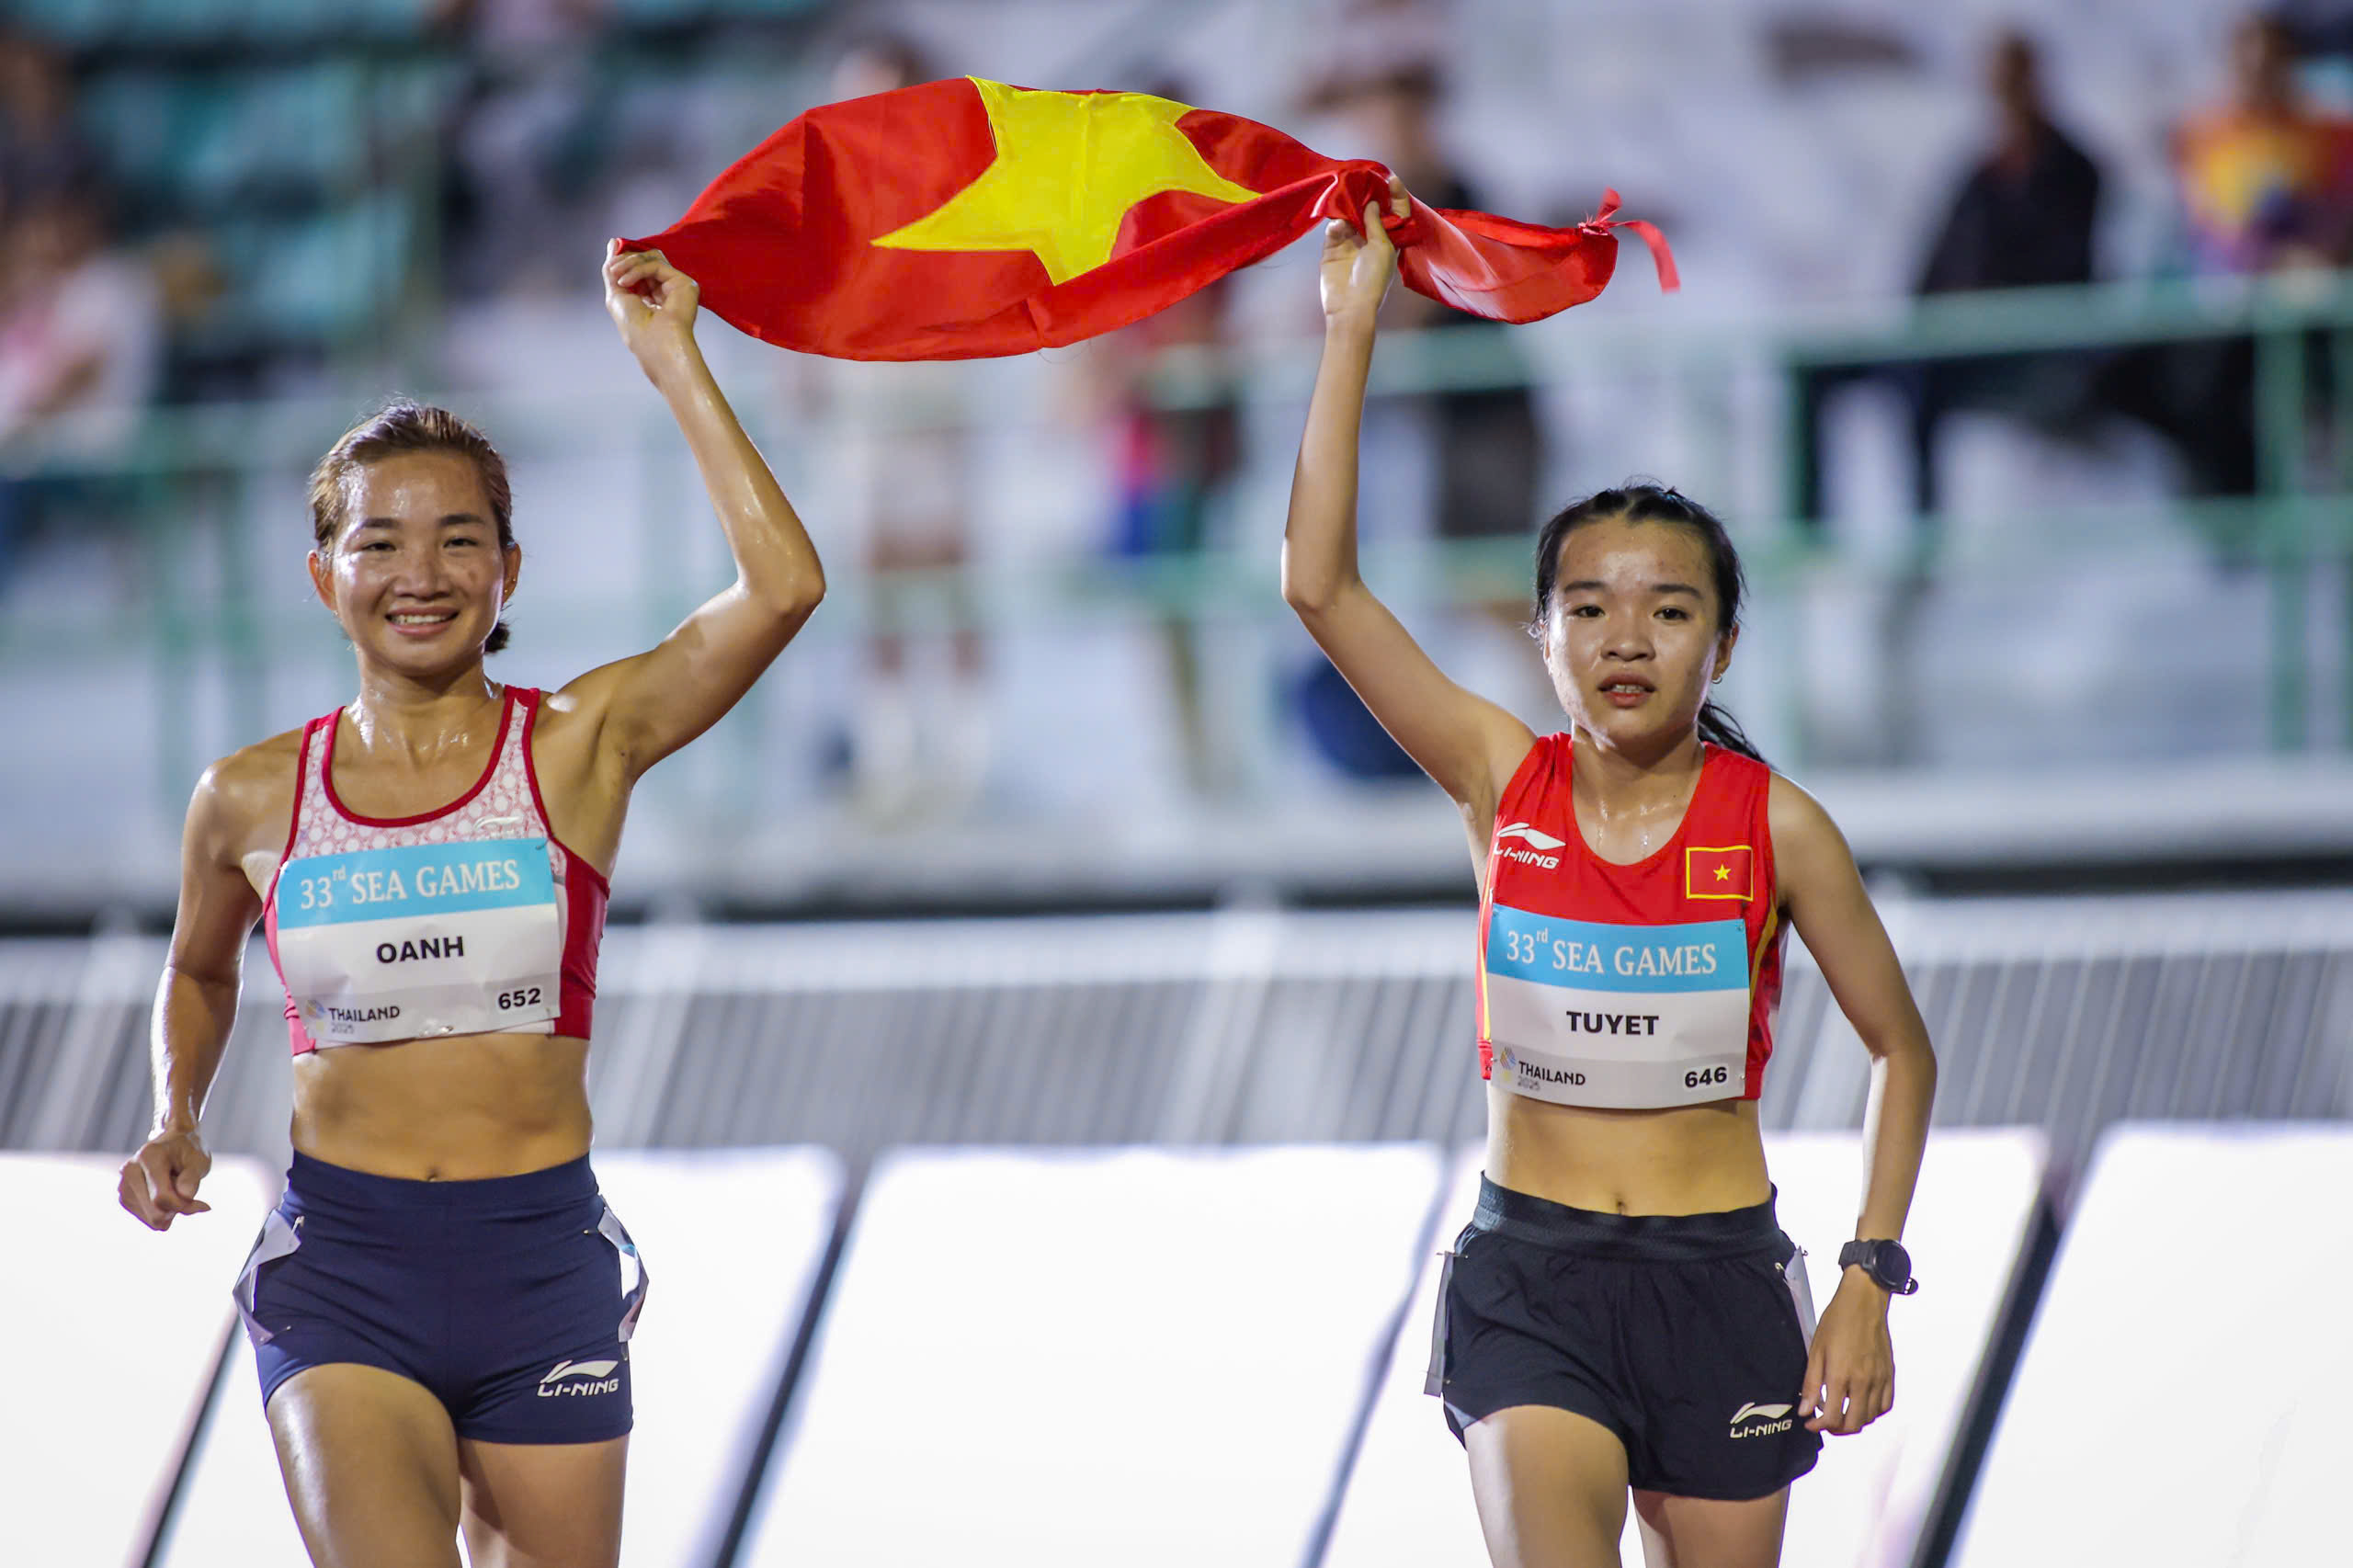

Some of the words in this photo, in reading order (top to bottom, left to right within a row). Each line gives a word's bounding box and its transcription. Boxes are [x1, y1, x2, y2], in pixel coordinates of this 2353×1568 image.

[1493, 841, 1560, 869] LI-NING
[351, 870, 407, 904] SEA
[415, 859, 520, 898] GAMES
[376, 936, 464, 964] OANH
[1552, 939, 1605, 973] SEA
[1614, 943, 1717, 976] GAMES
[497, 987, 541, 1010] 652
[328, 1006, 401, 1022] THAILAND
[1566, 1011, 1659, 1036] TUYET
[1518, 1061, 1586, 1085] THAILAND
[1684, 1066, 1728, 1088] 646
[537, 1379, 619, 1397] LI-NING
[1730, 1419, 1792, 1438] LI-NING
